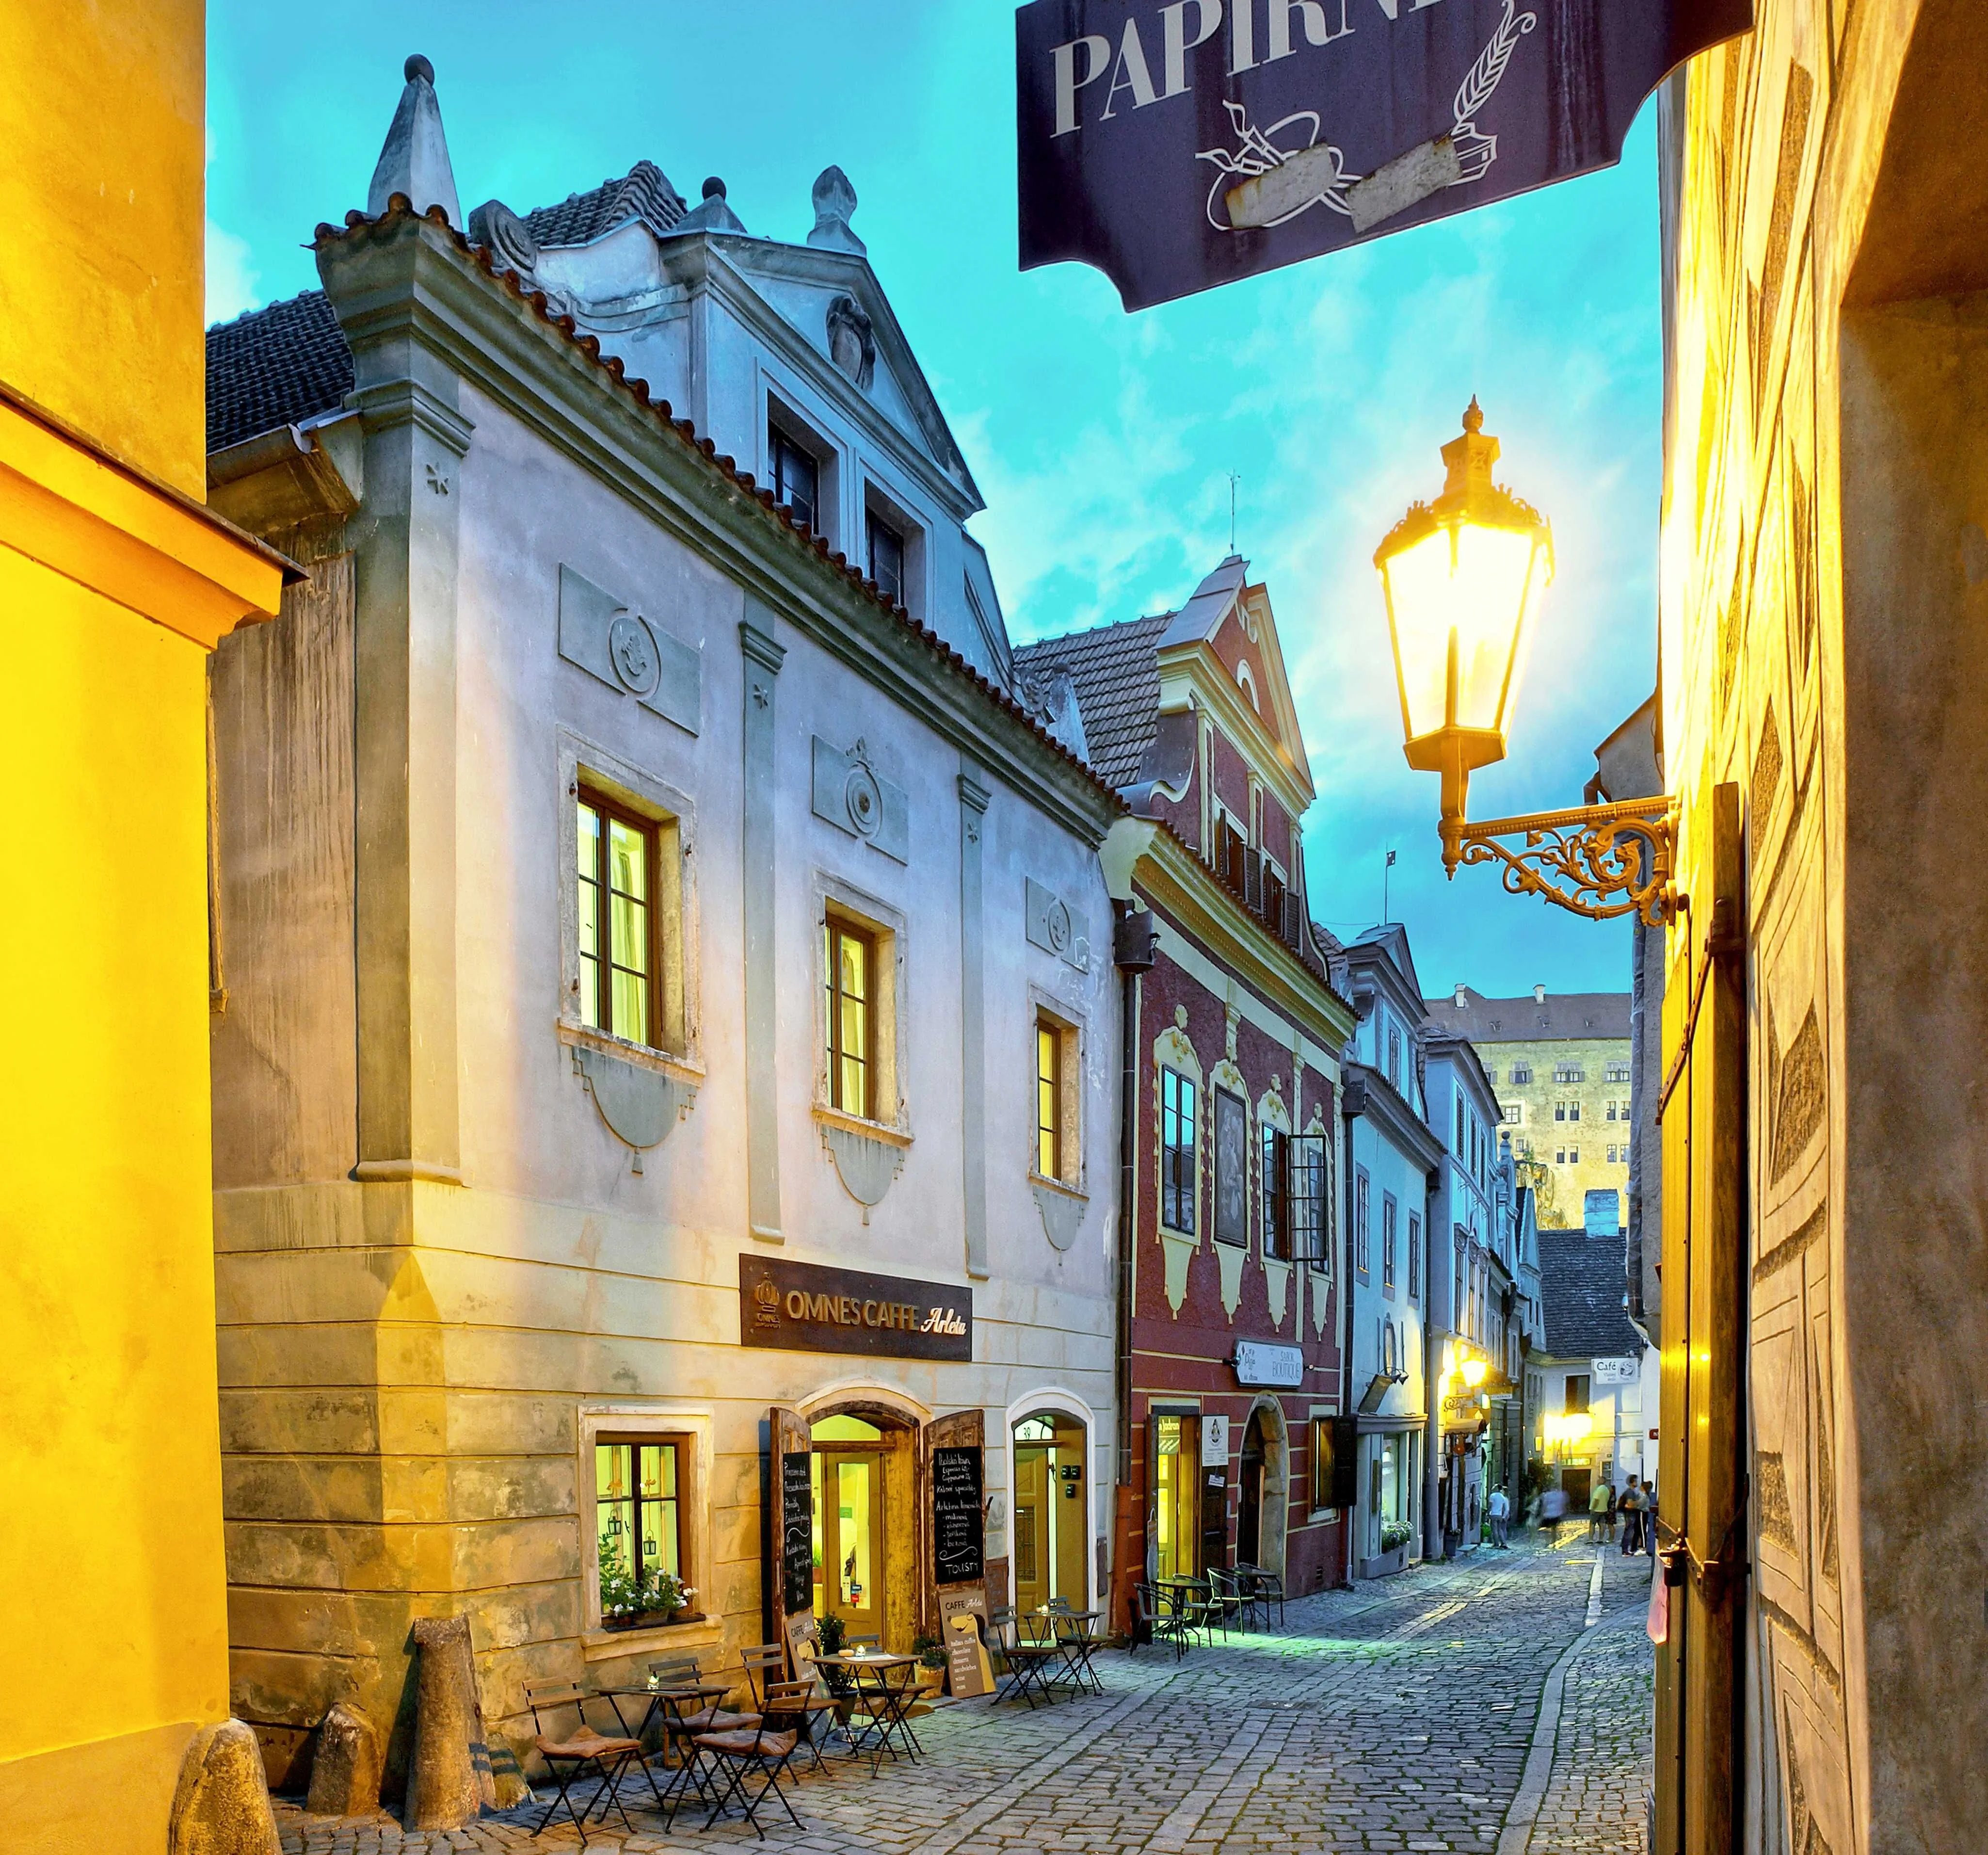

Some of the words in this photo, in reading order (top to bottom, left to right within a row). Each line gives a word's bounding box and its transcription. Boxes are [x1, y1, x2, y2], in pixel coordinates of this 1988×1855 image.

[920, 1307, 966, 1336] Arleta
[1597, 1361, 1616, 1371] Café
[946, 1562, 978, 1575] TOUSTY
[946, 1600, 965, 1610] CAFFE
